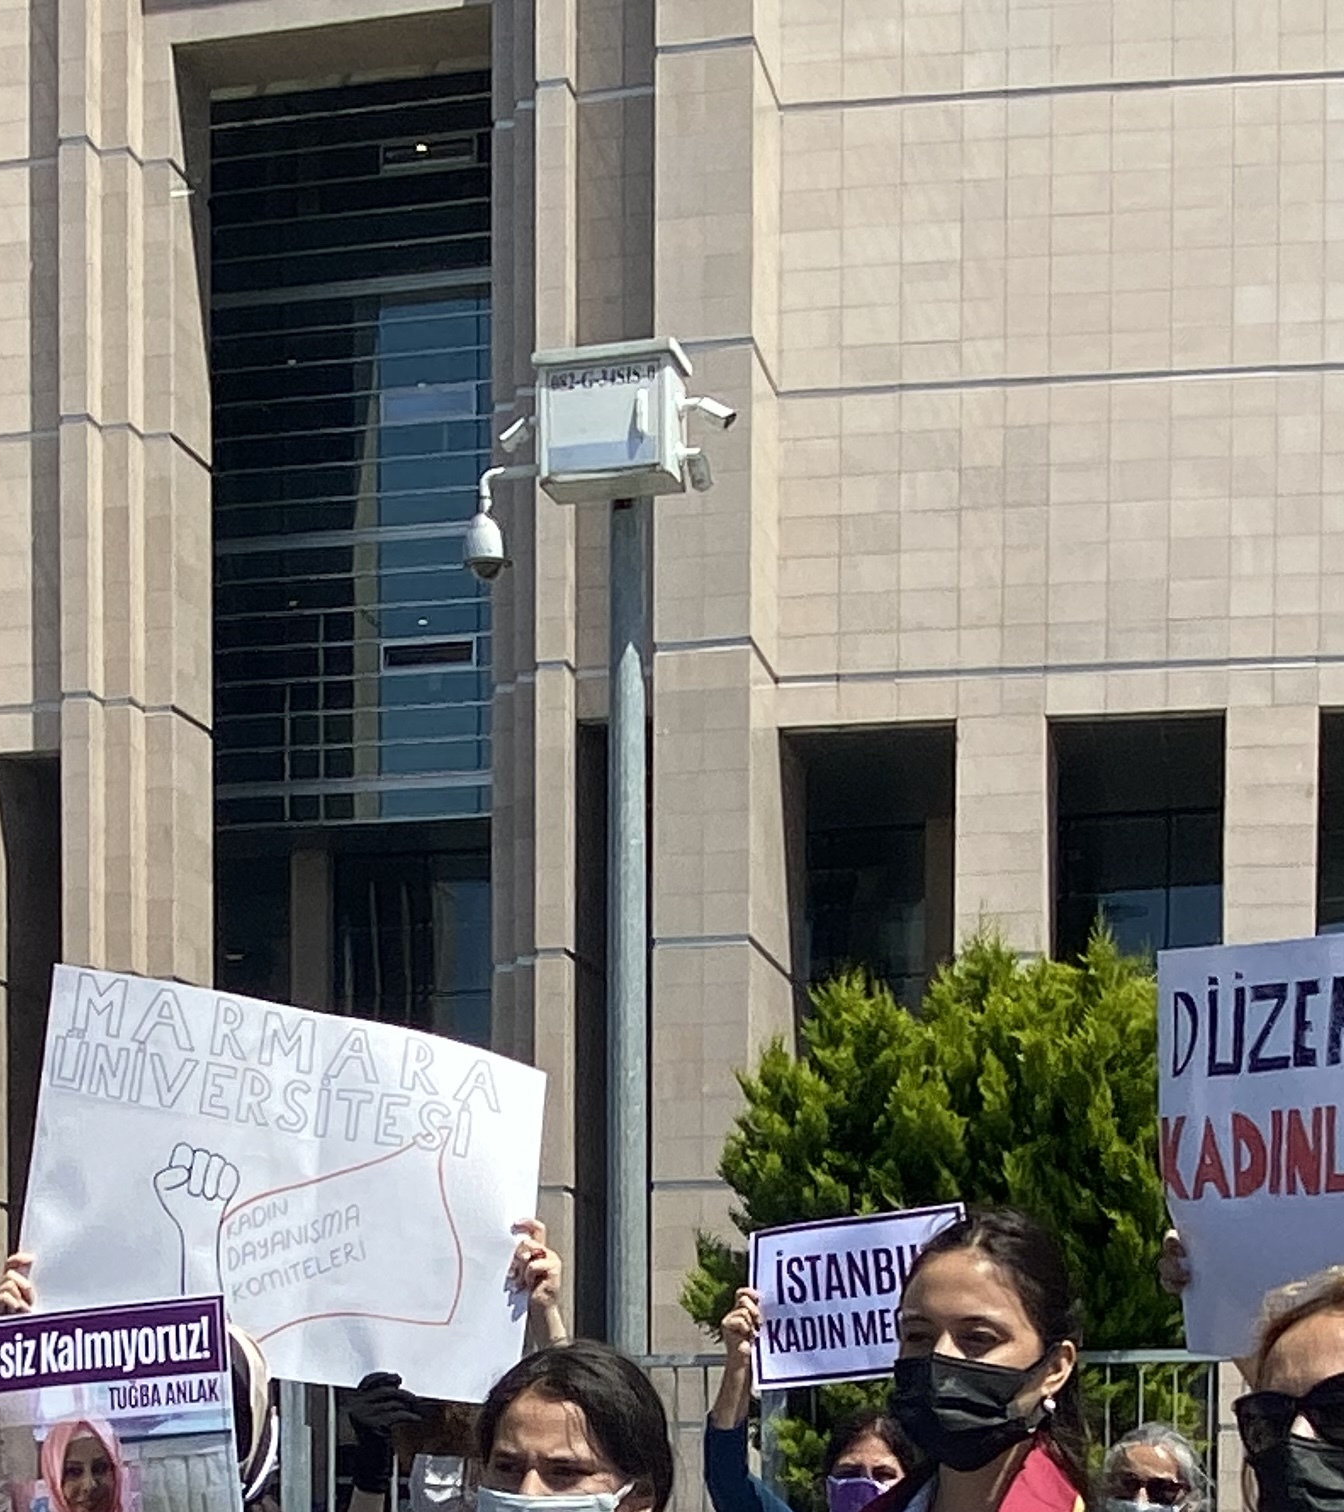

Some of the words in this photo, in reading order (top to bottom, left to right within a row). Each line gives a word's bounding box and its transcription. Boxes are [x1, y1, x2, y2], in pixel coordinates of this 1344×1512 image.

[72, 973, 502, 1113] MARMARA
[776, 1244, 918, 1306] İSTANBU
[40, 1316, 211, 1376] Kalmıyoruz!
[767, 1313, 847, 1354] KADIN
[109, 1379, 162, 1411] TUĞBA
[165, 1376, 221, 1404] ANLAK
